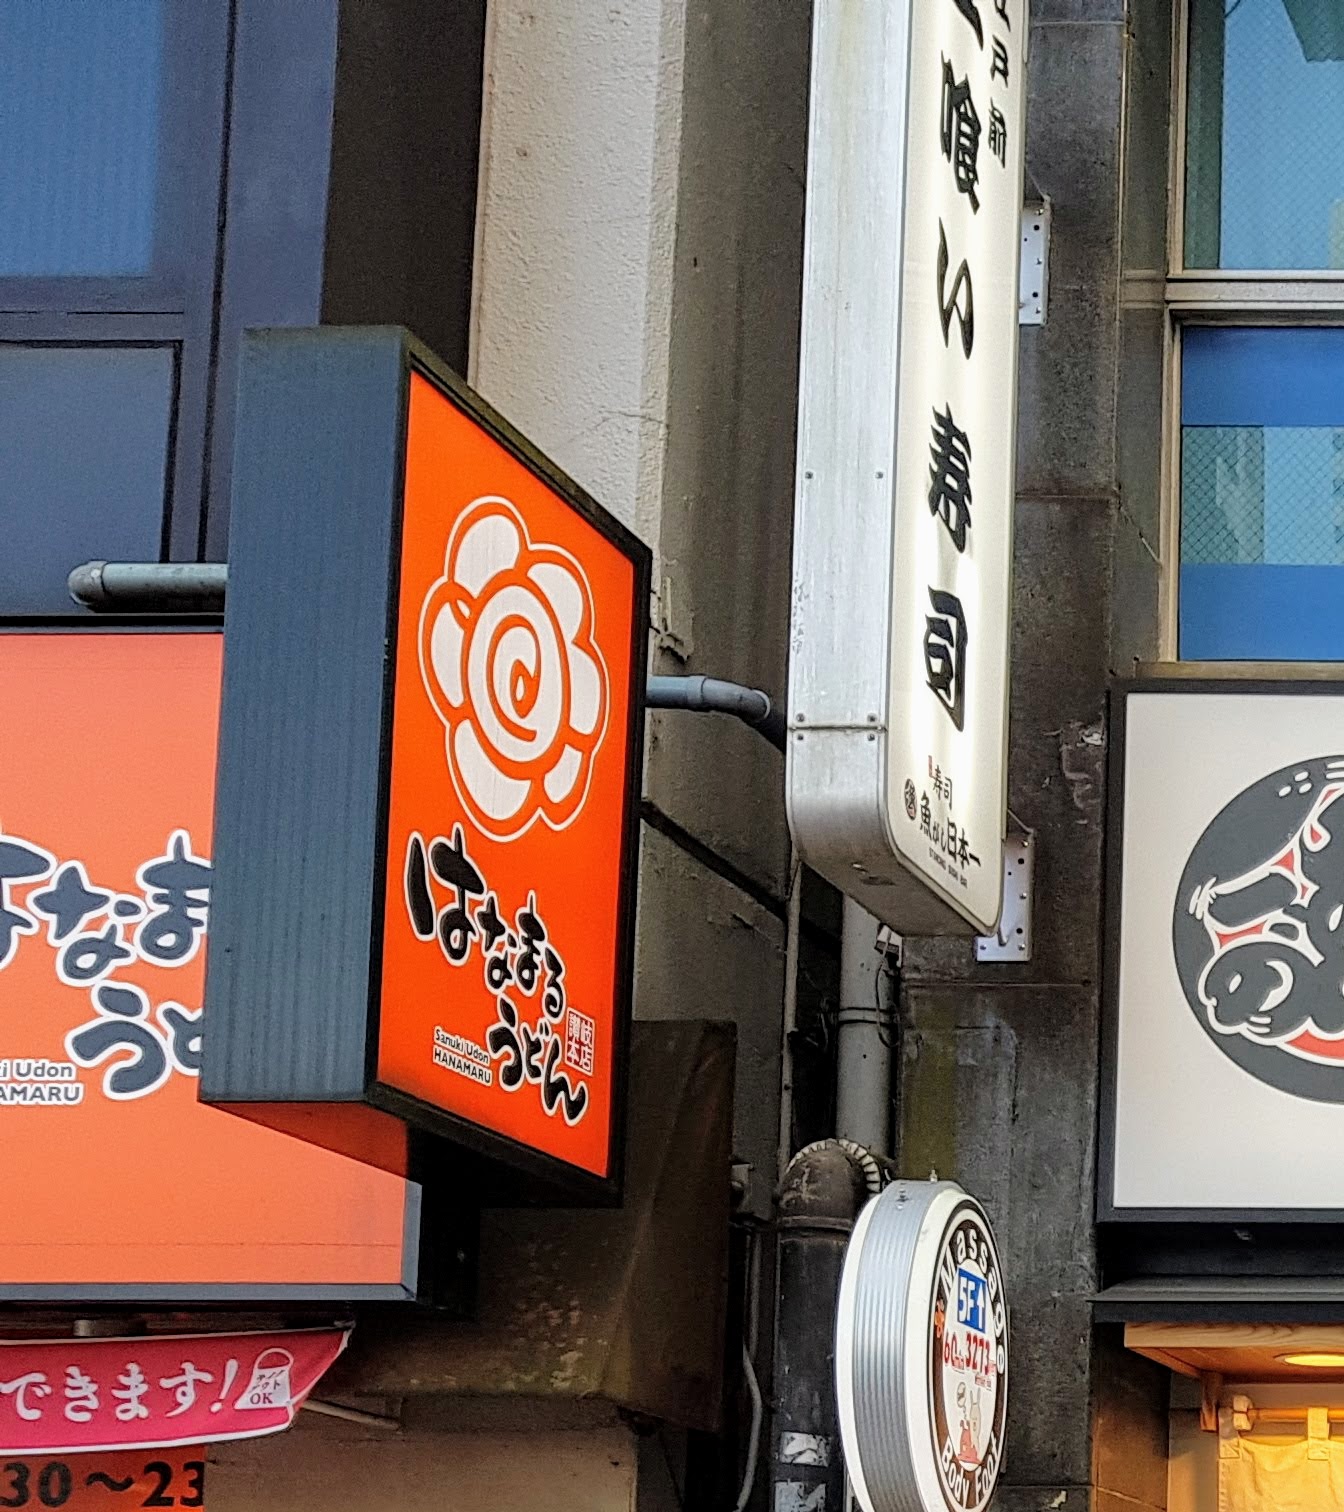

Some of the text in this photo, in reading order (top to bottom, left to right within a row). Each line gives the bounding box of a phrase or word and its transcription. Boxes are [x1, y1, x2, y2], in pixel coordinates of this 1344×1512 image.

[925, 0, 983, 731] 喰い寿司
[407, 825, 564, 1018] はなまる
[16, 1062, 72, 1077] Udon
[434, 1047, 491, 1085] HANAMARU
[435, 1028, 489, 1065] Sanuki Udon
[489, 997, 586, 1120] うどん
[940, 1228, 1005, 1375] Massage
[957, 1275, 976, 1325] 5F
[250, 1393, 273, 1405] OK
[943, 1431, 999, 1507] Body Foot
